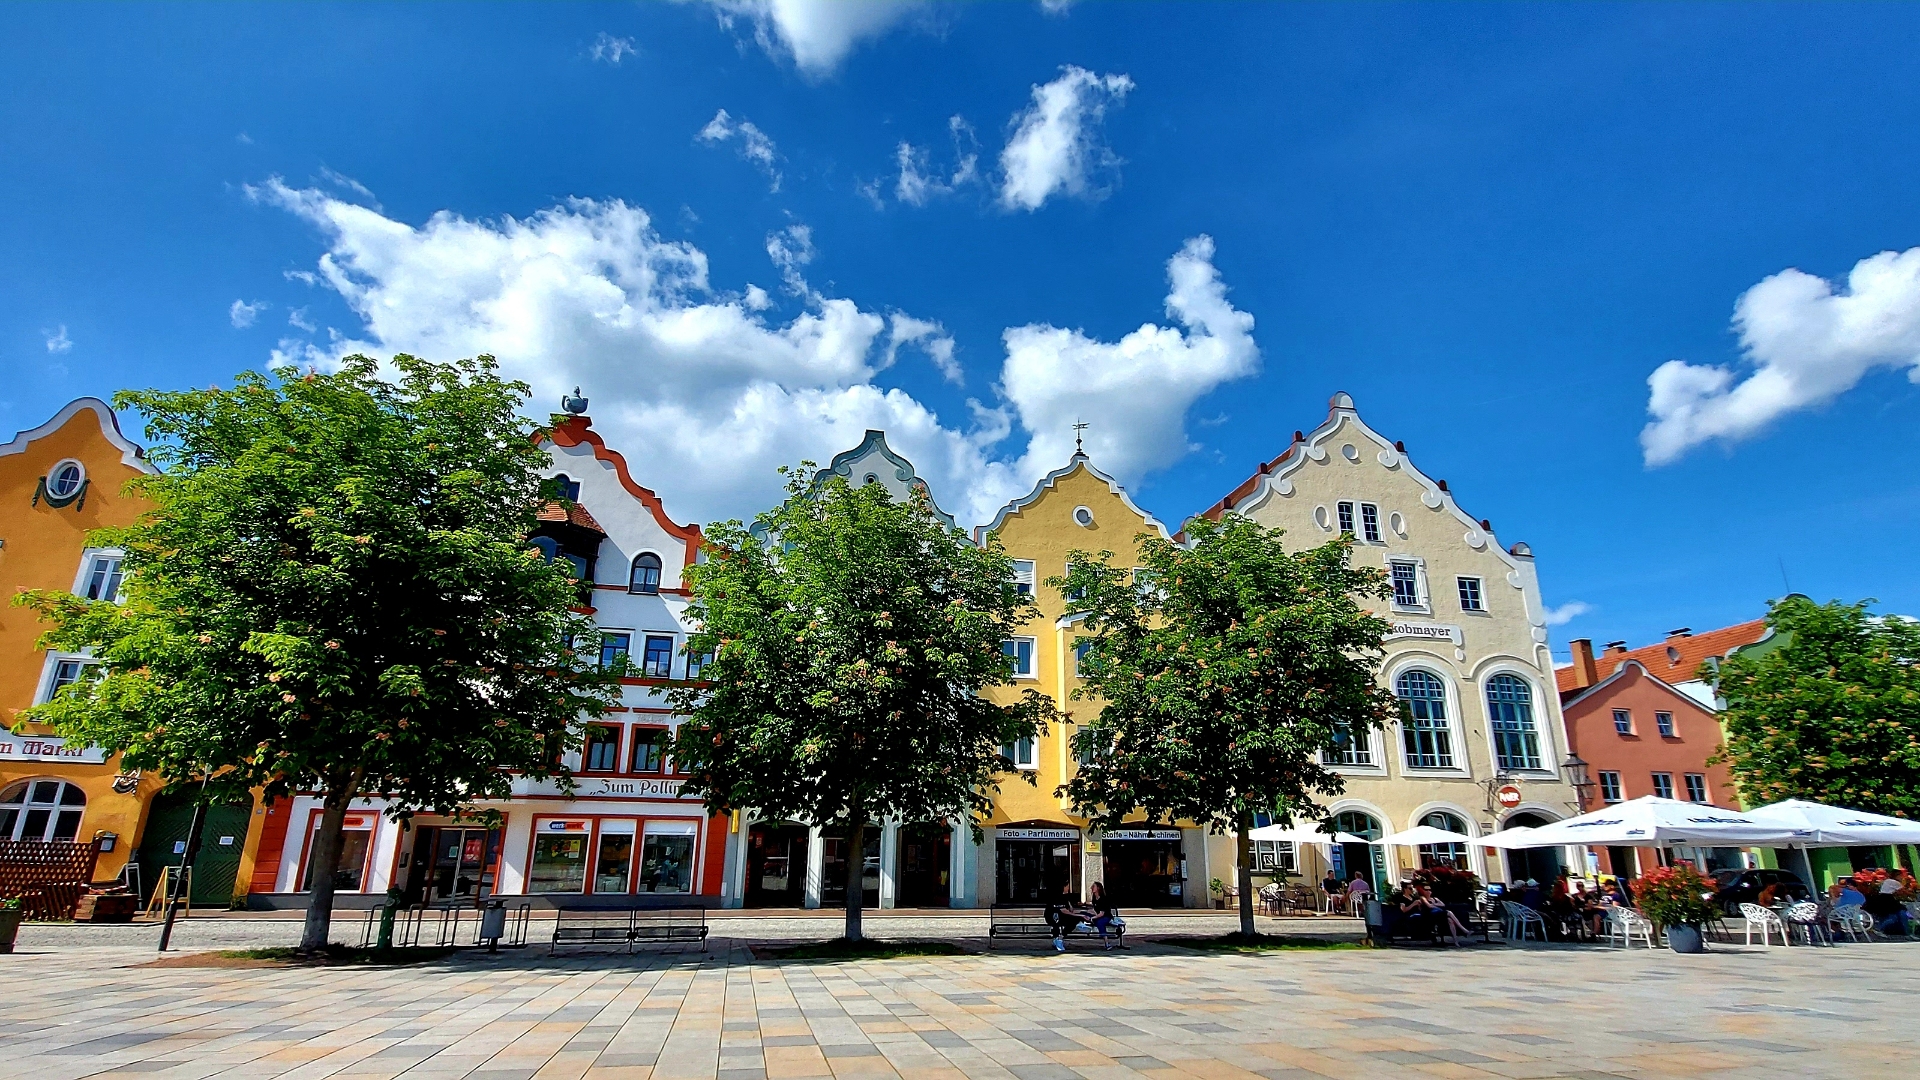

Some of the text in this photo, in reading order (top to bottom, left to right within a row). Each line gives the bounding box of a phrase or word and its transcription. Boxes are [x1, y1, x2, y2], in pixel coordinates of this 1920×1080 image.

[1003, 830, 1020, 838] Foto
[1028, 830, 1070, 838] Parfümerie
[1129, 831, 1179, 839] Nähmschinen
